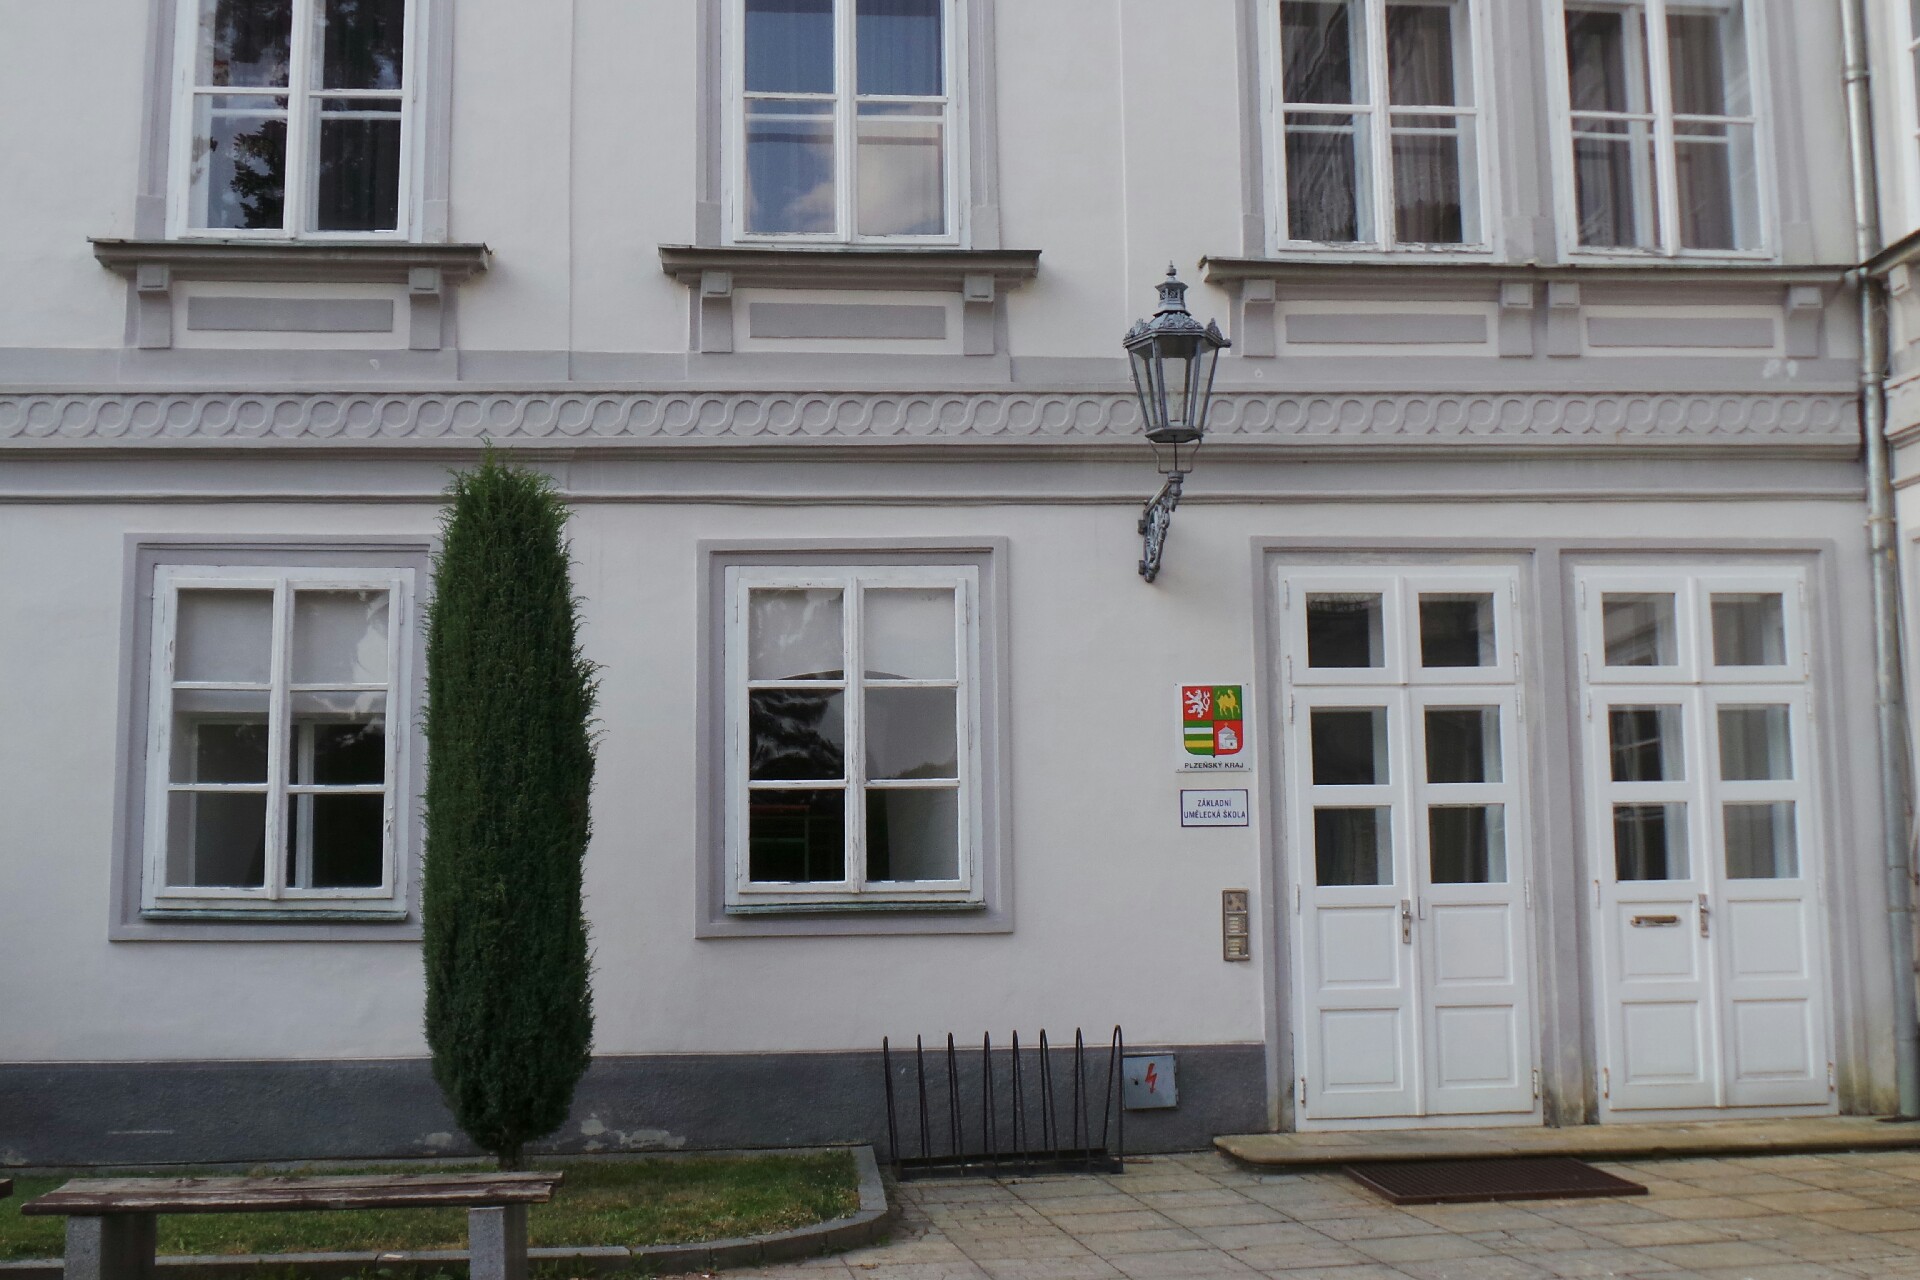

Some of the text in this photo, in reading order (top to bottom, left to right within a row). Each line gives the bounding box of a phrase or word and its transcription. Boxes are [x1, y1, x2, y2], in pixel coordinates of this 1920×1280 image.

[1184, 761, 1223, 769] PLZEŇSKÝ
[1197, 797, 1232, 807] ZÁKLADNÍ
[1184, 809, 1246, 818] UMĚLECKÁ ŠKOLA
